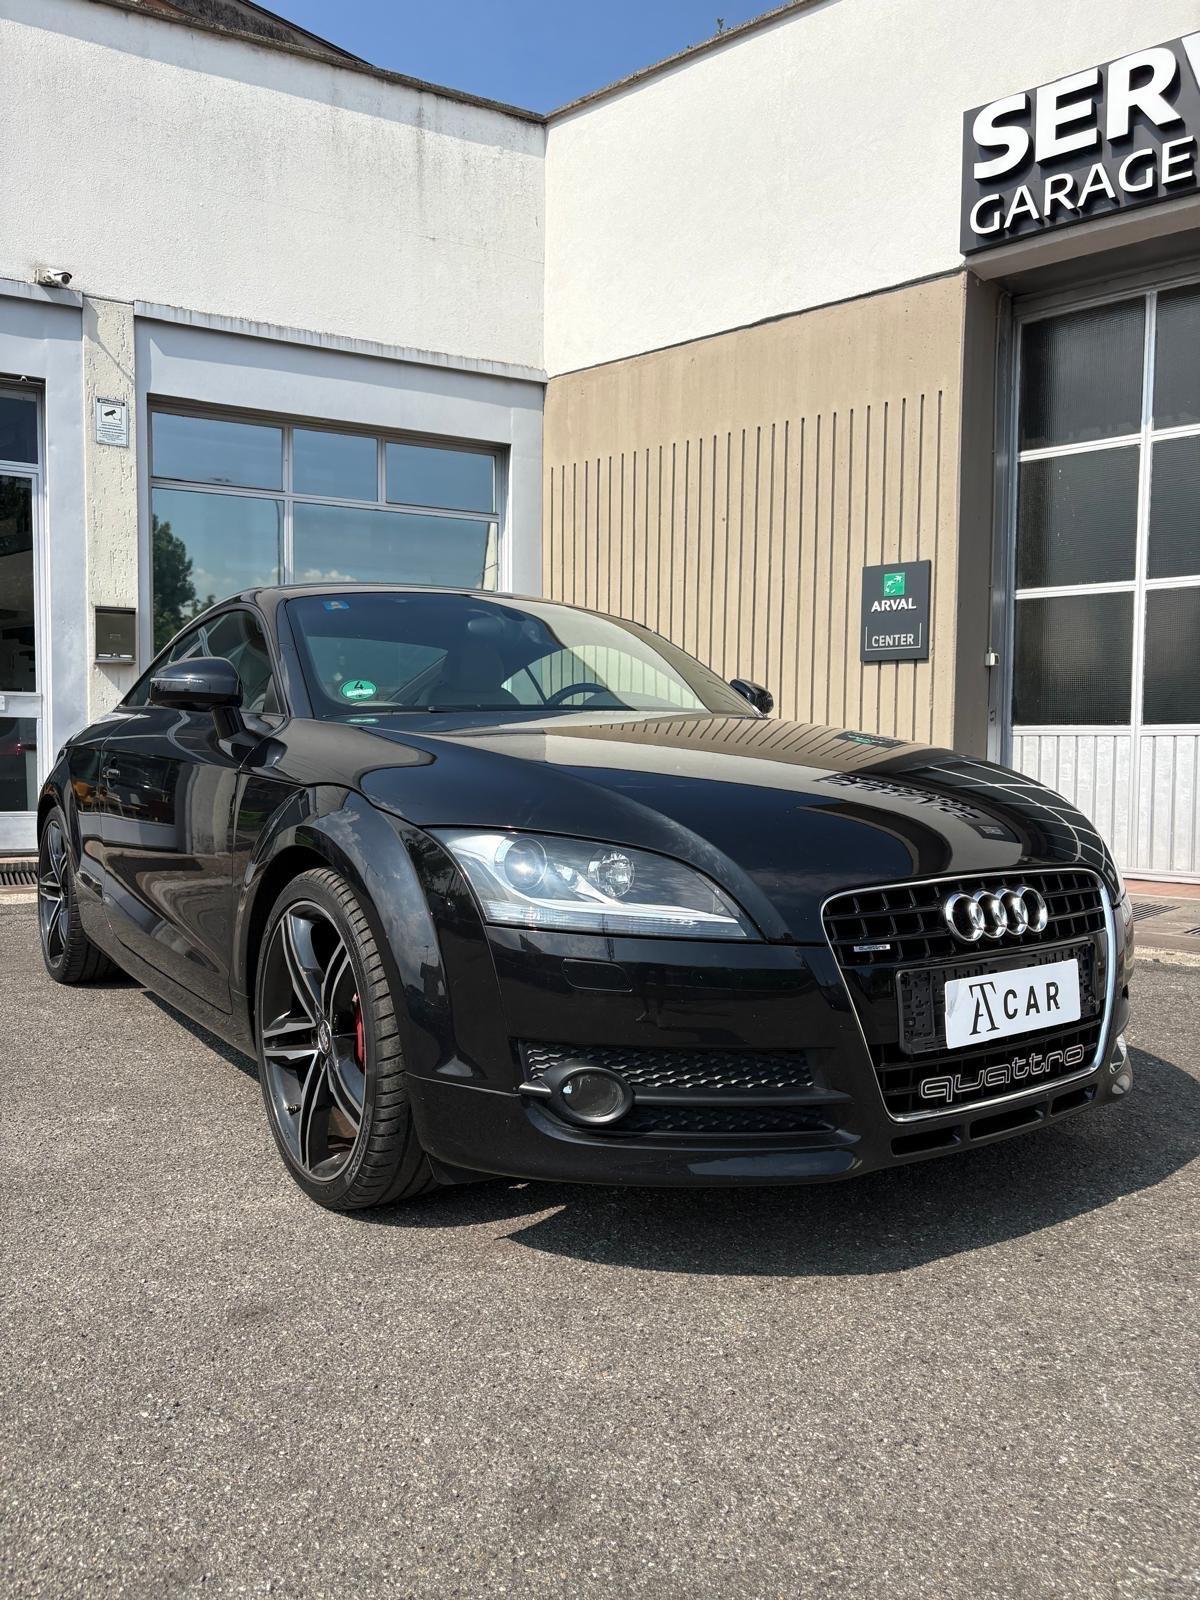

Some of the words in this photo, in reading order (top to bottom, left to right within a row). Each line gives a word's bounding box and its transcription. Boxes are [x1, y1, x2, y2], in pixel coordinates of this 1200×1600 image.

[972, 33, 1200, 181] SER
[969, 135, 1195, 235] GARAGE
[871, 598, 916, 612] ARVAL
[872, 633, 914, 647] CENTER
[1003, 981, 1060, 1020] CAR
[920, 1044, 1084, 1102] quattro
